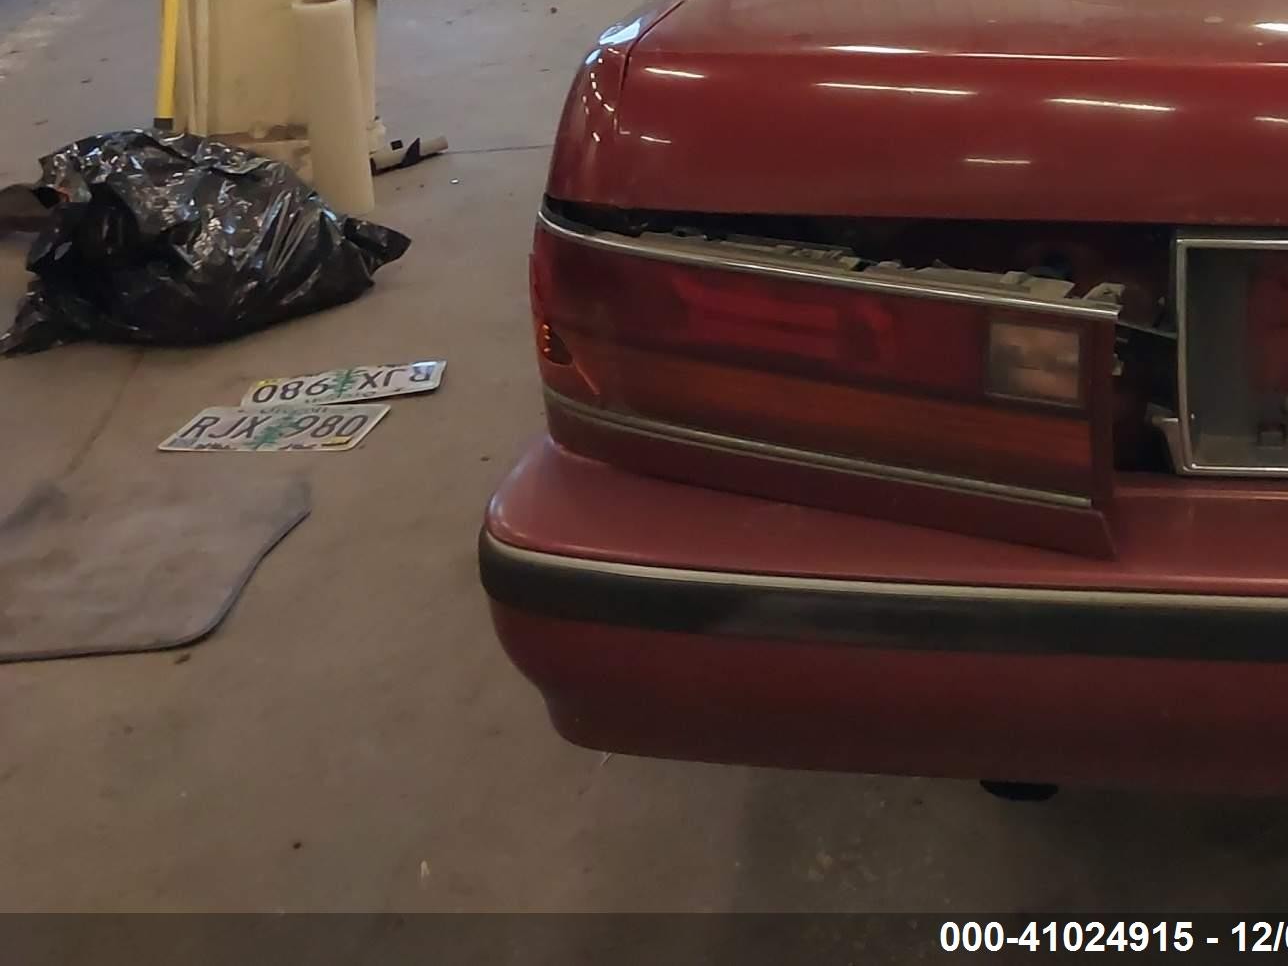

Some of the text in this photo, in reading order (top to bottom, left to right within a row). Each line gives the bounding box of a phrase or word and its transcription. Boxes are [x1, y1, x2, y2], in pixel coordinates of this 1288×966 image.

[358, 363, 434, 390] RJX
[251, 378, 330, 404] 980
[178, 414, 369, 439] RJX 980
